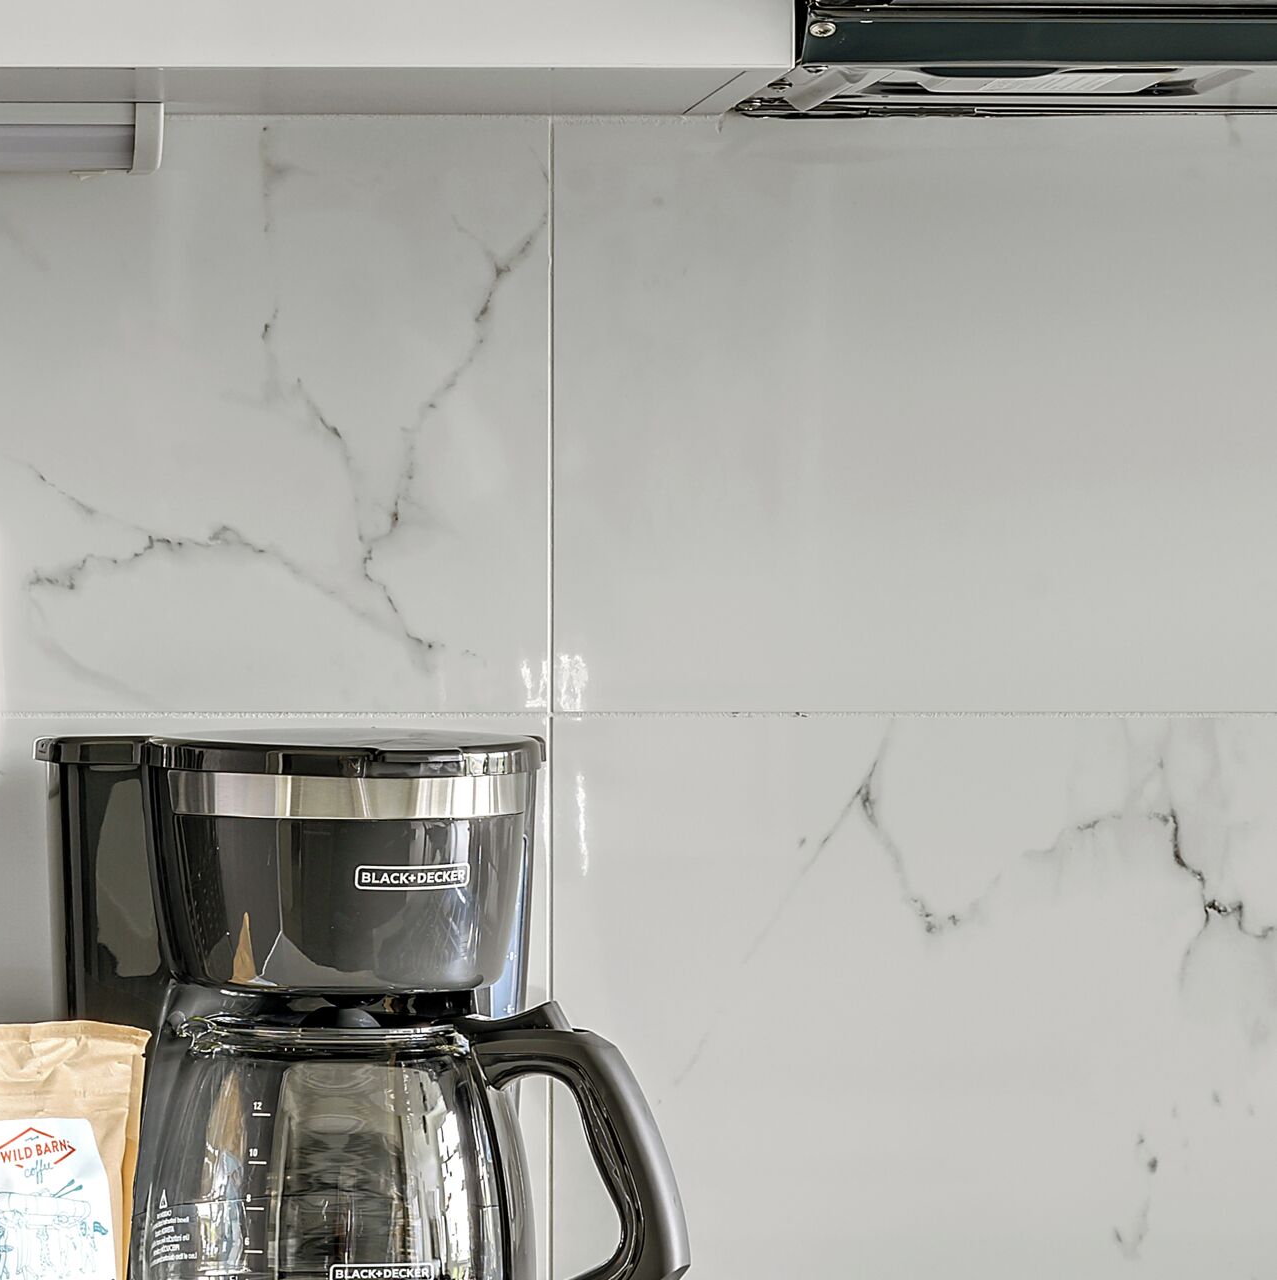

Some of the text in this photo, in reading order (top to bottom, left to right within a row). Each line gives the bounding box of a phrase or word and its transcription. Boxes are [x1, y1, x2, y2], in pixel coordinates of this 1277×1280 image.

[361, 869, 466, 884] BLACK+DECKER
[253, 1102, 263, 1111] 12
[0, 1139, 68, 1163] WILD BARN
[249, 1148, 259, 1157] 10
[24, 1159, 54, 1184] coffee
[246, 1194, 252, 1202] 8
[334, 1267, 430, 1280] BLACK+DECKER
